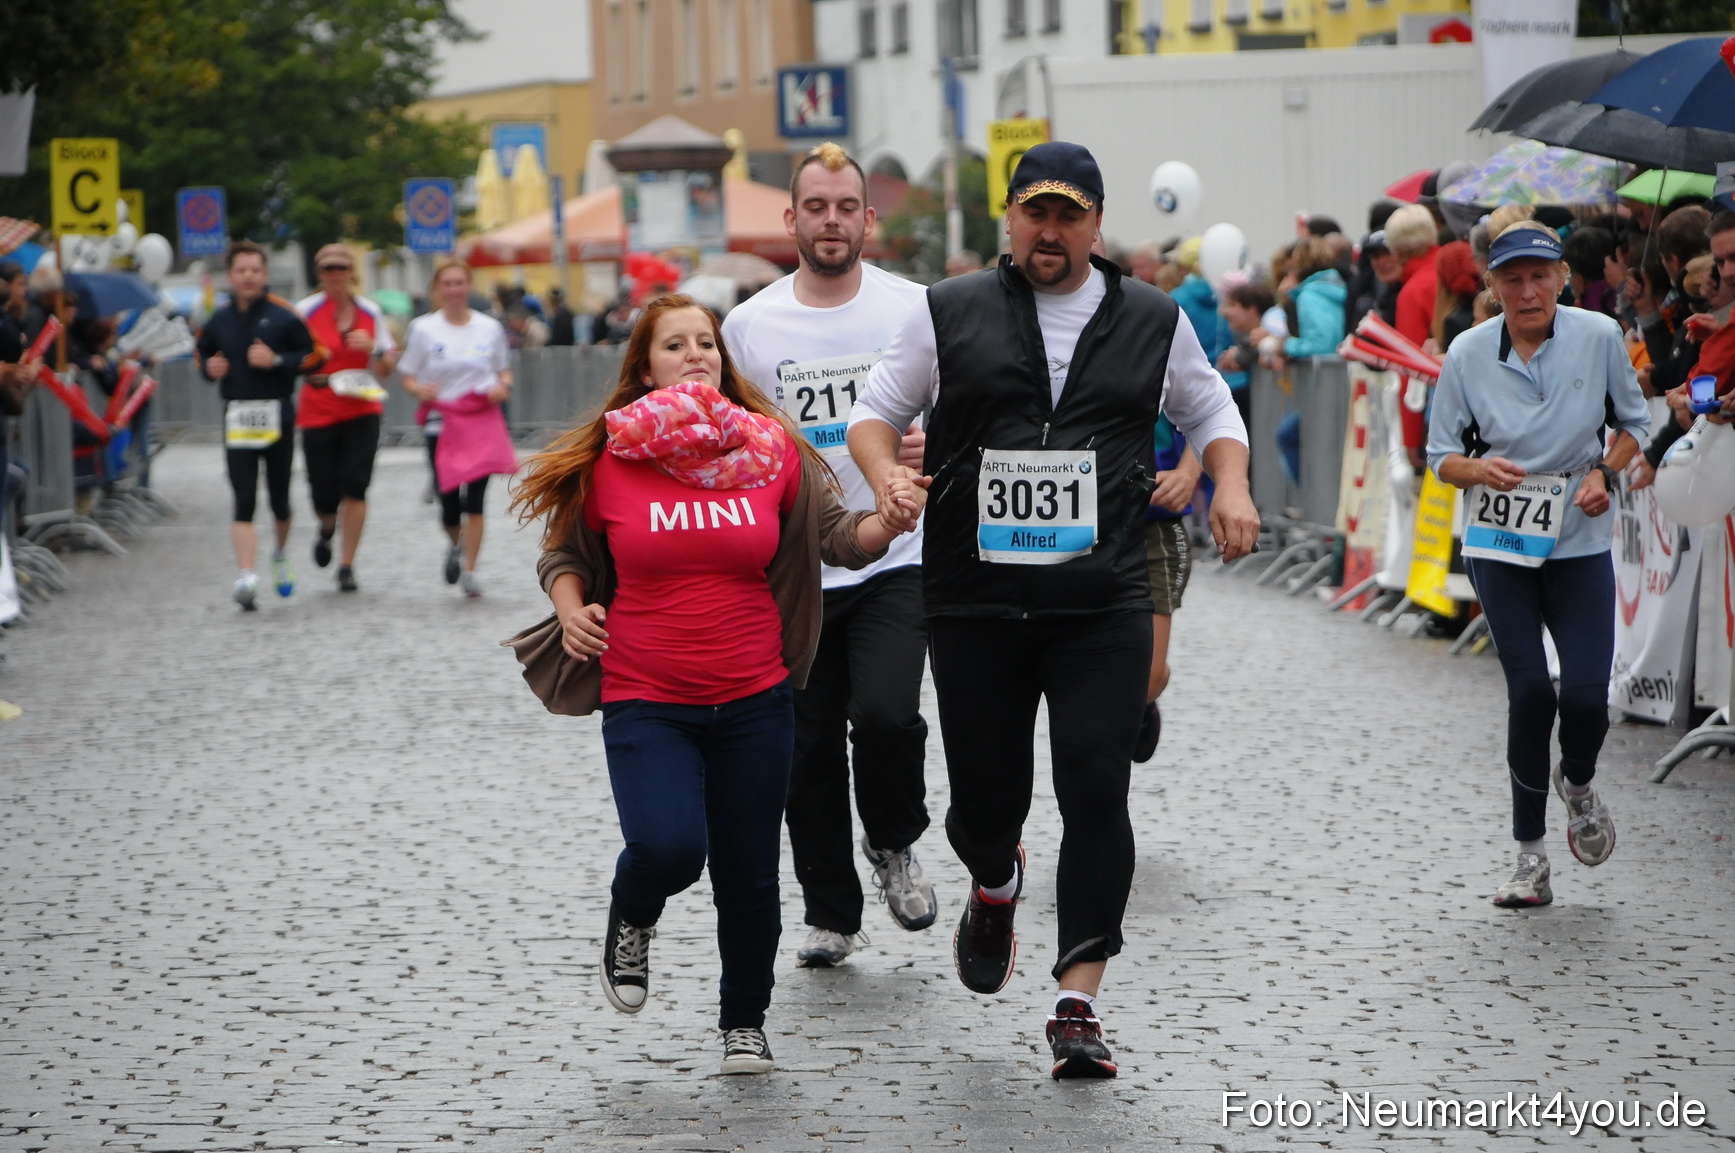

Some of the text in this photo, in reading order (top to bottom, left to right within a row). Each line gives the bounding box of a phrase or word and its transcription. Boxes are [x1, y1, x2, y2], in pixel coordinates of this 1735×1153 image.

[70, 169, 101, 215] C
[784, 364, 871, 384] PARTL Neumarkt
[796, 380, 866, 422] 211
[815, 427, 848, 445] Matt
[1017, 463, 1074, 473] Neumarkt
[987, 479, 1080, 520] 3031
[1478, 491, 1552, 532] 2974
[650, 497, 756, 532] MINI
[1011, 531, 1057, 548] Alfred
[1493, 533, 1524, 551] Heidi
